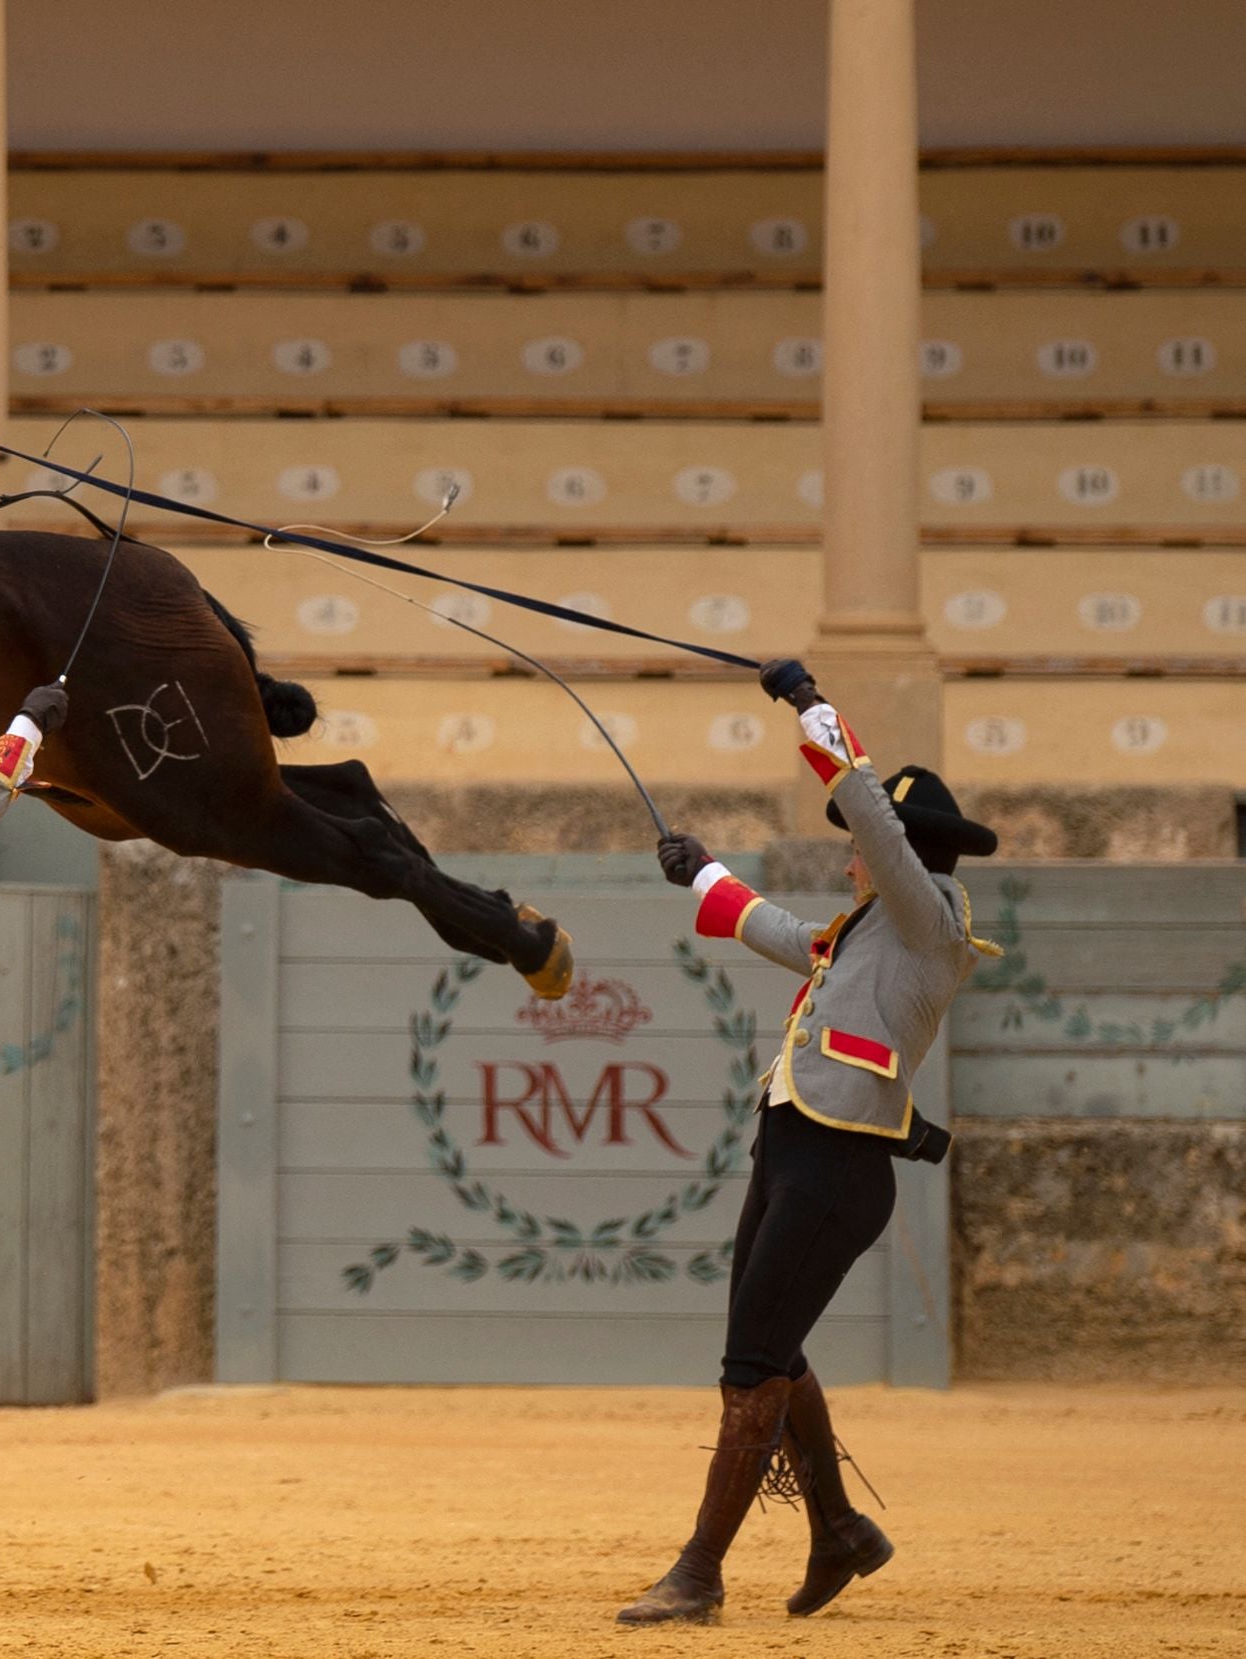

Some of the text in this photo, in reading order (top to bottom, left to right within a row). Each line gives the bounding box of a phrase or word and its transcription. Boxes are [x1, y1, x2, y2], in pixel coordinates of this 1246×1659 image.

[1021, 221, 1057, 249] 10
[1138, 221, 1169, 249] 11
[545, 343, 566, 370] 6
[673, 343, 694, 372] 7
[1054, 342, 1089, 370] 10
[1172, 340, 1203, 371] 11
[954, 473, 976, 500] 9
[1076, 468, 1110, 498] 10
[473, 1060, 699, 1161] RMR
